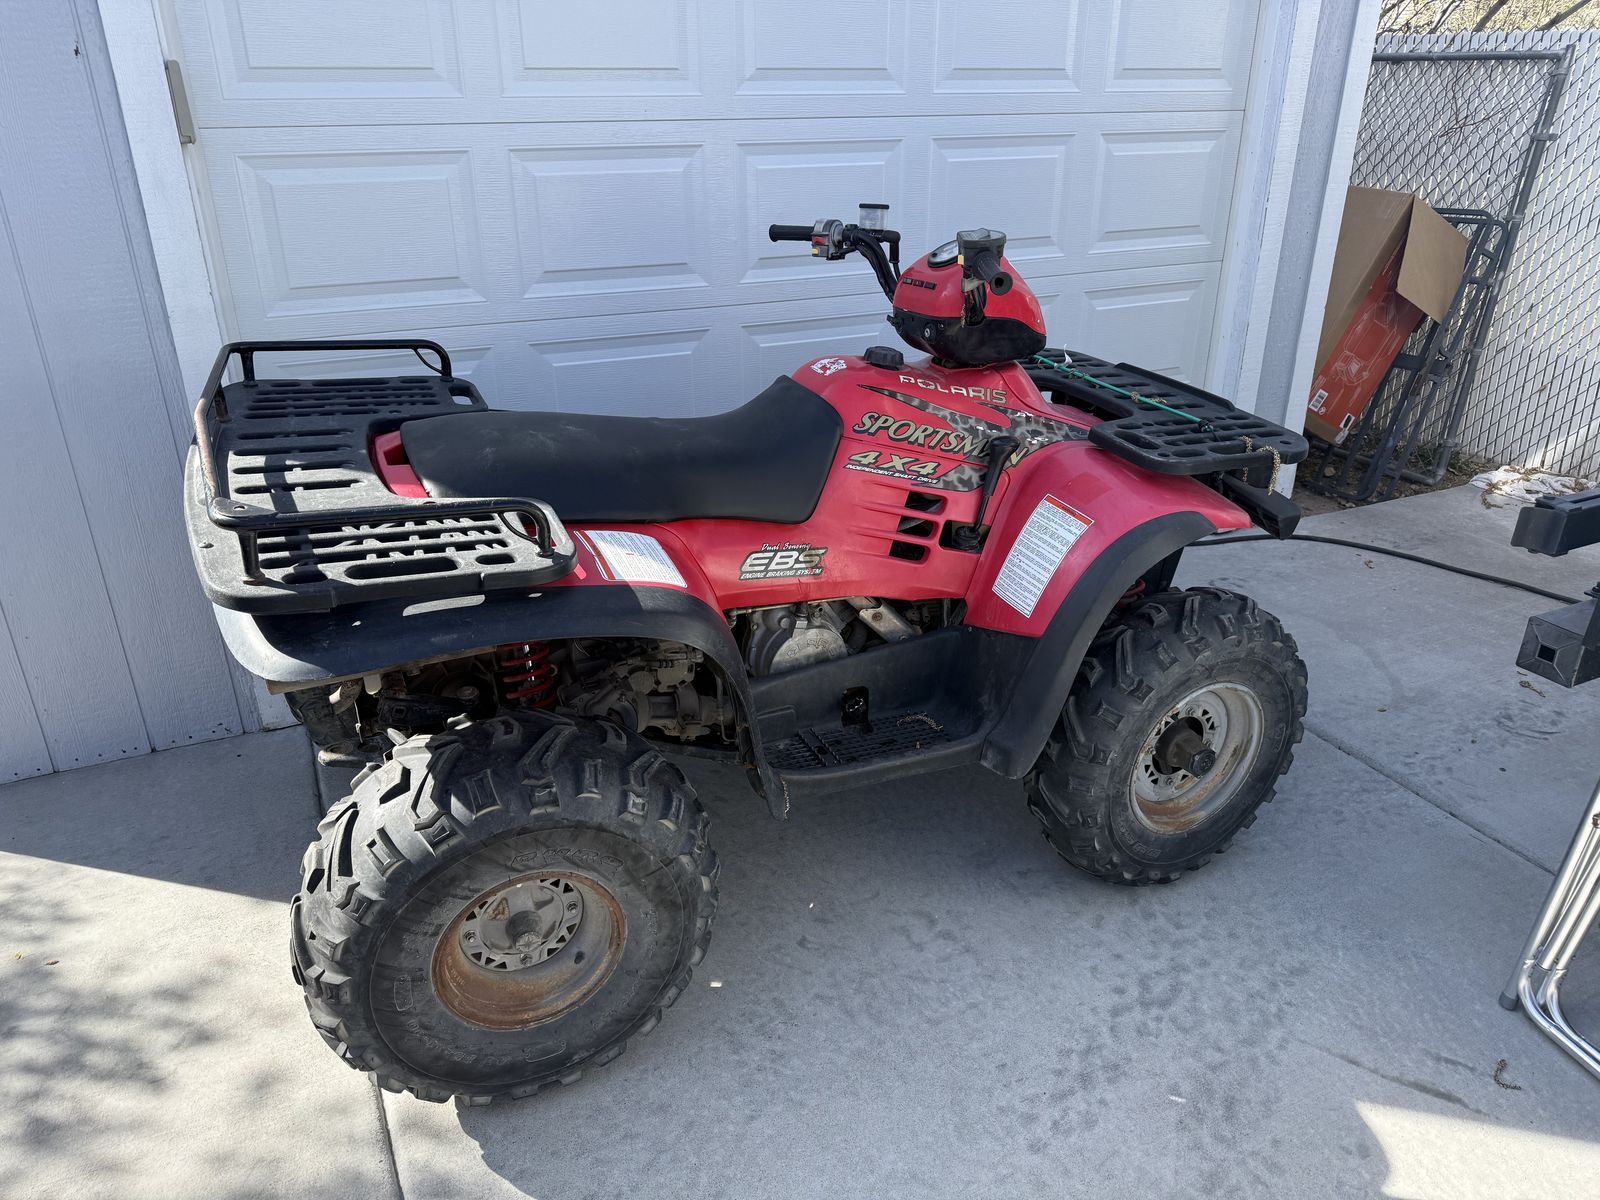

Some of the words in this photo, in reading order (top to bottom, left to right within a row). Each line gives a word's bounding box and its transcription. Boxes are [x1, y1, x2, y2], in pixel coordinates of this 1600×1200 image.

[899, 374, 1007, 404] POLARIS
[853, 411, 1029, 467] SPORTSMN
[845, 464, 894, 476] INDEPENDENT
[894, 471, 917, 481] SHAFT
[917, 476, 939, 484] DRIVE
[848, 450, 940, 477] 4X4
[741, 547, 828, 572] EBS
[761, 543, 780, 551] Dual
[740, 571, 766, 580] ENGINE
[766, 569, 795, 578] BRAKING
